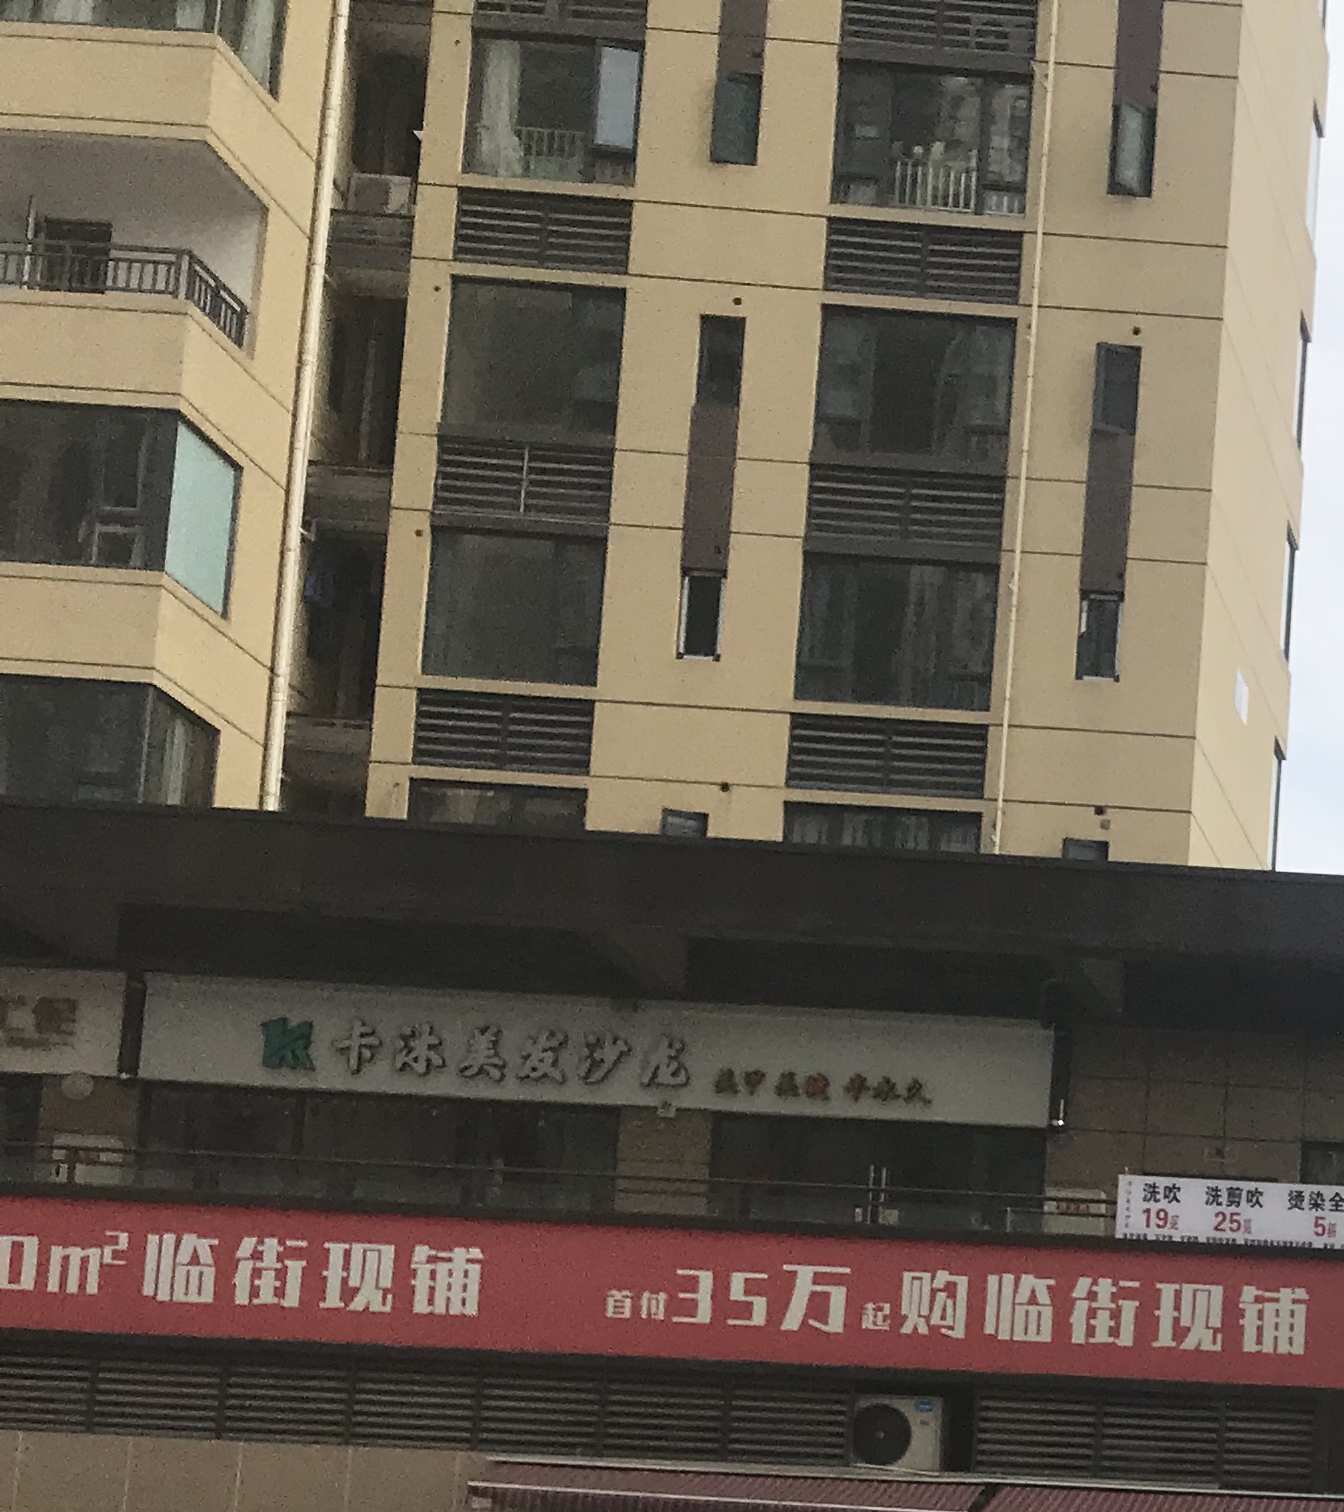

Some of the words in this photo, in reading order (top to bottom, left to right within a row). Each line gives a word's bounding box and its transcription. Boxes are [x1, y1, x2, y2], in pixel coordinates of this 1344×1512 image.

[1142, 1182, 1182, 1204] 洗吹
[1204, 1186, 1264, 1208] 洗剪吹
